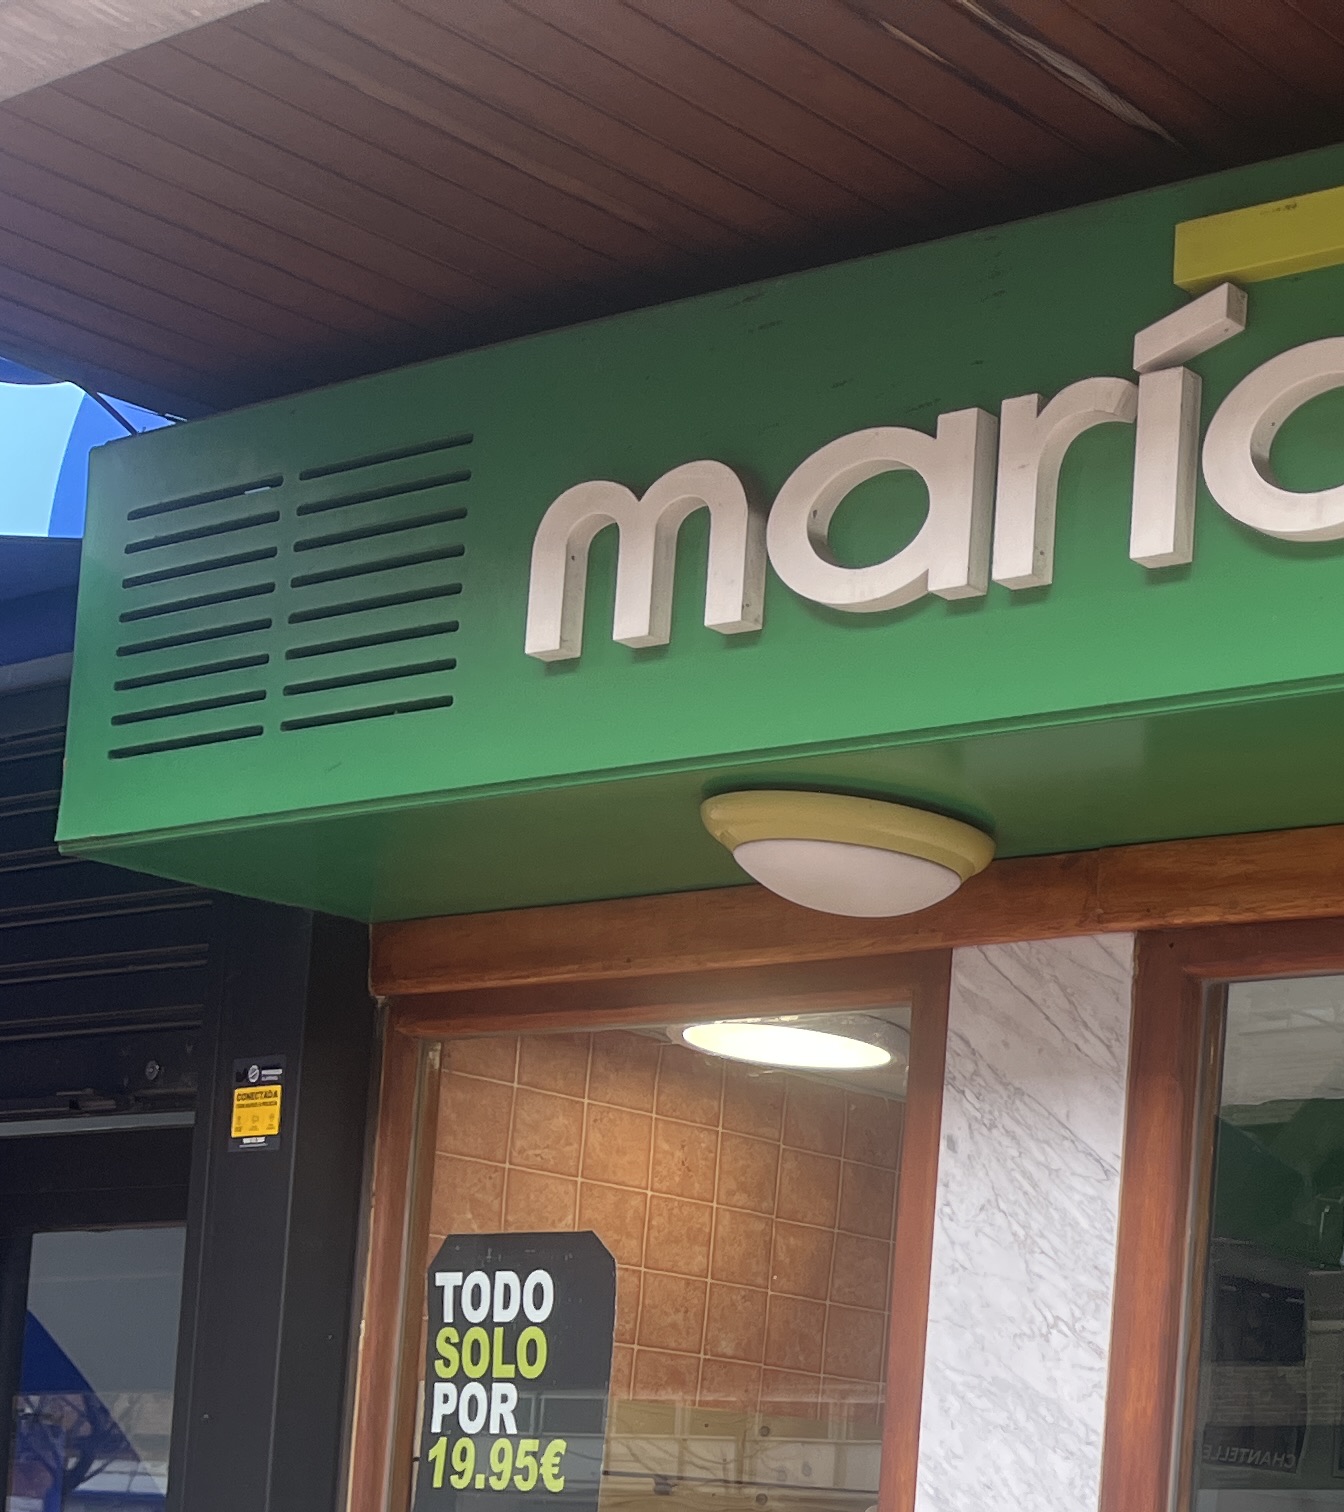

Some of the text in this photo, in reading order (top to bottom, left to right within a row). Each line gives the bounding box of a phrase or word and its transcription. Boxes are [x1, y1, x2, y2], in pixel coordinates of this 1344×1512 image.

[435, 1269, 554, 1323] TODO
[434, 1326, 548, 1379] SOLO
[430, 1382, 518, 1434] POR
[427, 1437, 567, 1492] 19.95€
